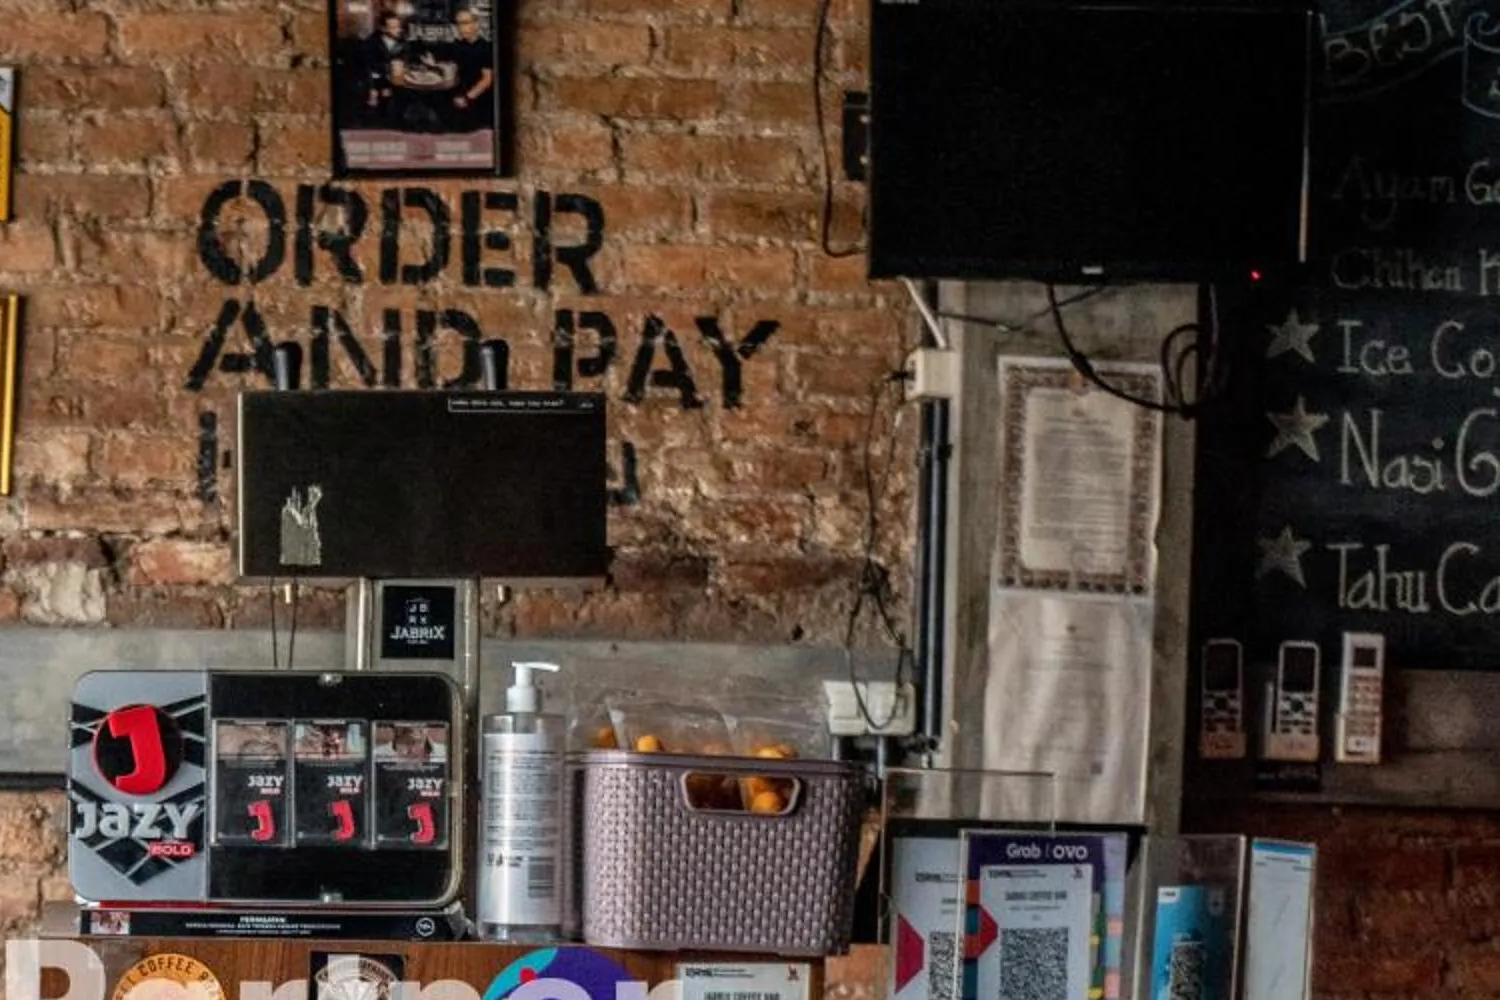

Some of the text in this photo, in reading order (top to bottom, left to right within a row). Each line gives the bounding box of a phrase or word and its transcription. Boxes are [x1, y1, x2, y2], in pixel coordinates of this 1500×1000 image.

[200, 178, 604, 295] ORDER
[185, 298, 780, 409] AND PAY
[1336, 319, 1414, 377] Ice
[1338, 407, 1446, 495] Nasi
[1326, 543, 1431, 613] Tahu
[389, 624, 446, 641] JABRIX
[151, 844, 193, 857] BOLD
[1005, 842, 1042, 859] Grab
[138, 956, 195, 977] COFFEE
